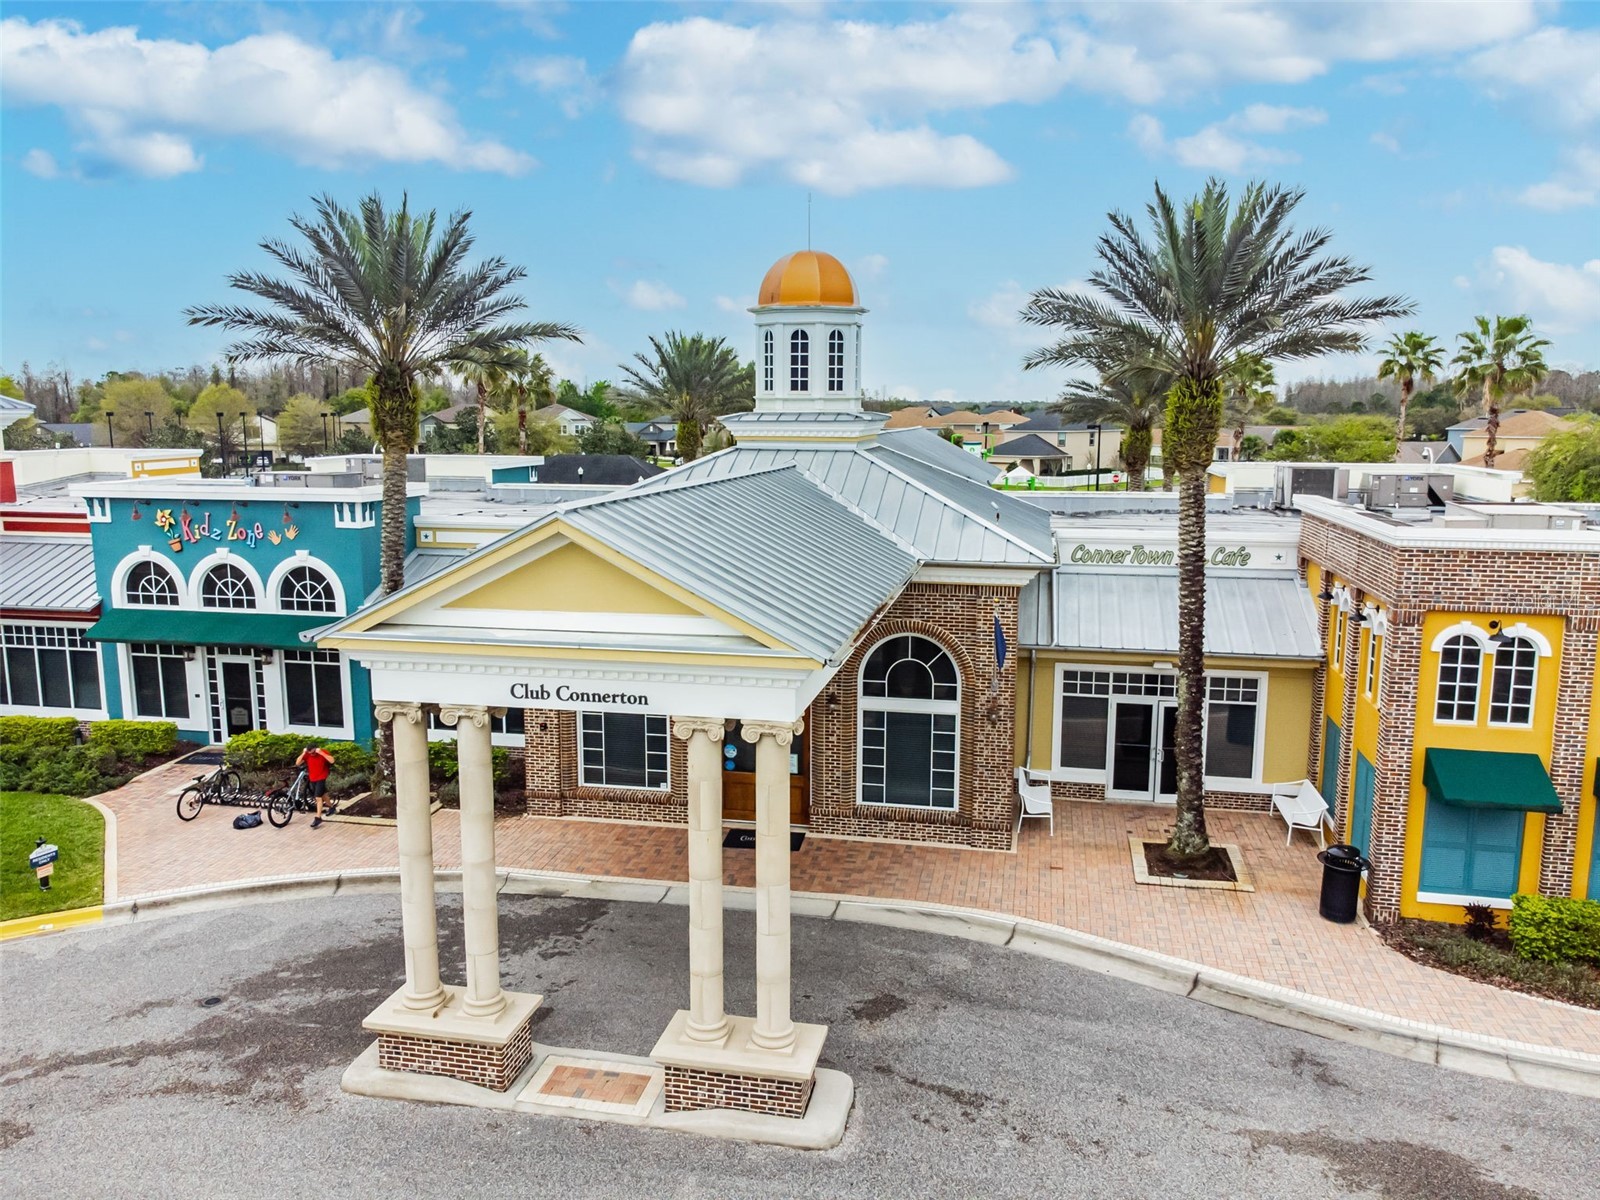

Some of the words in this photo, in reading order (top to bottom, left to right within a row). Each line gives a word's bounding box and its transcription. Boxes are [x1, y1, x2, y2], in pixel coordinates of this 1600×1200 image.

[181, 512, 222, 543] Kidz
[226, 519, 264, 548] Zone
[1211, 546, 1252, 566] Cafe
[510, 682, 551, 700] Club
[555, 685, 649, 706] Connerton
